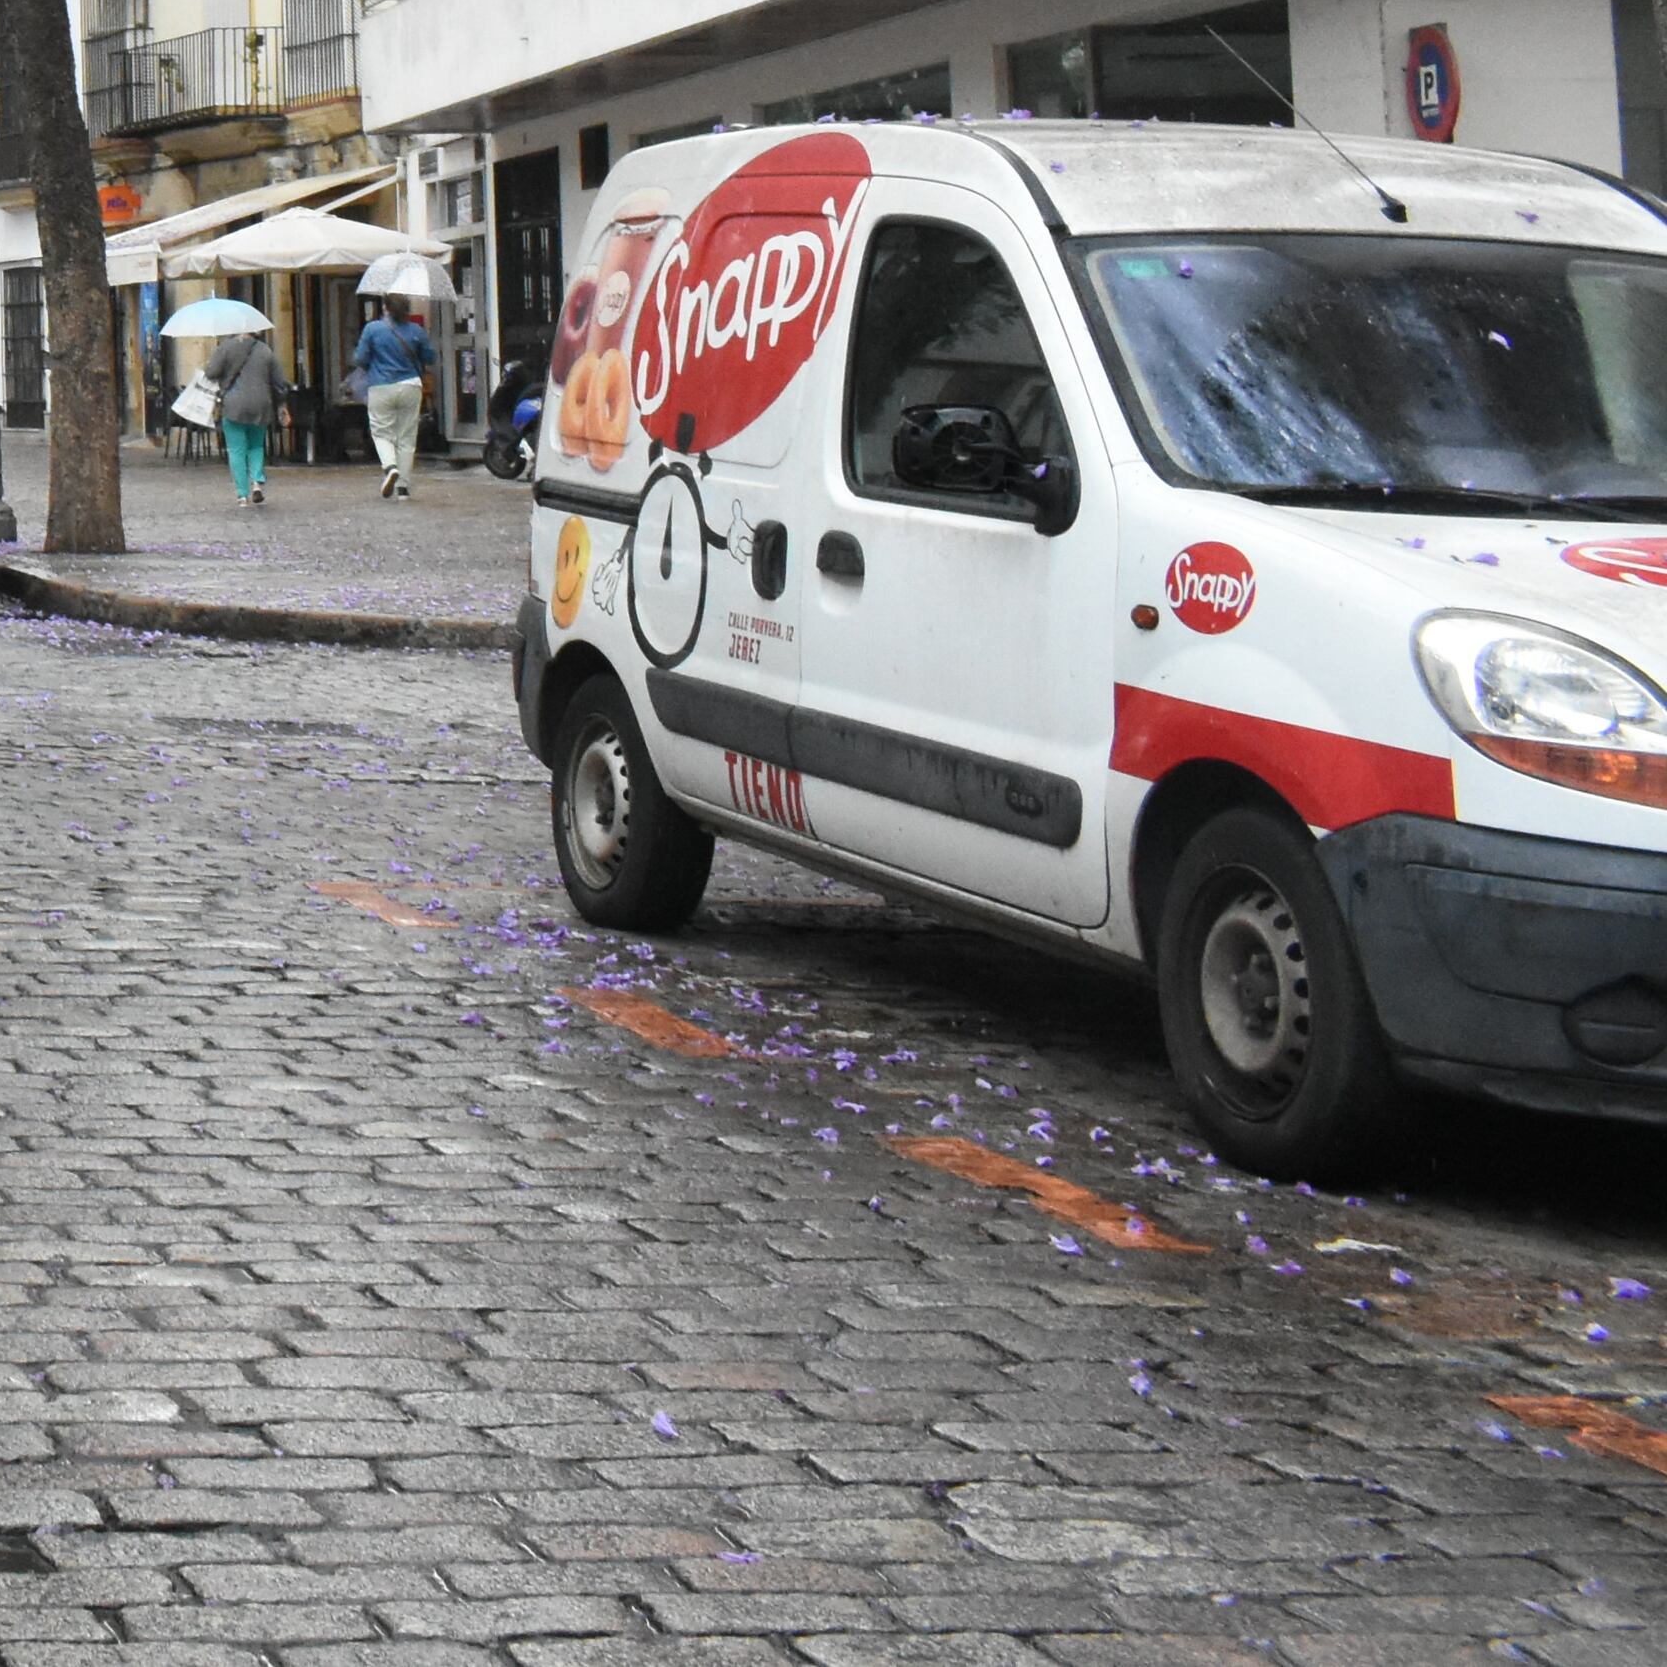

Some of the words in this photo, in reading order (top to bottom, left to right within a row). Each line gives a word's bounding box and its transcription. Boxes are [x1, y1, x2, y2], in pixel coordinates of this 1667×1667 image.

[1423, 71, 1435, 101] P
[636, 178, 870, 416] Snappy
[1167, 552, 1257, 618] Snappy
[728, 612, 749, 631] CALLE
[728, 633, 761, 665] JEREZ
